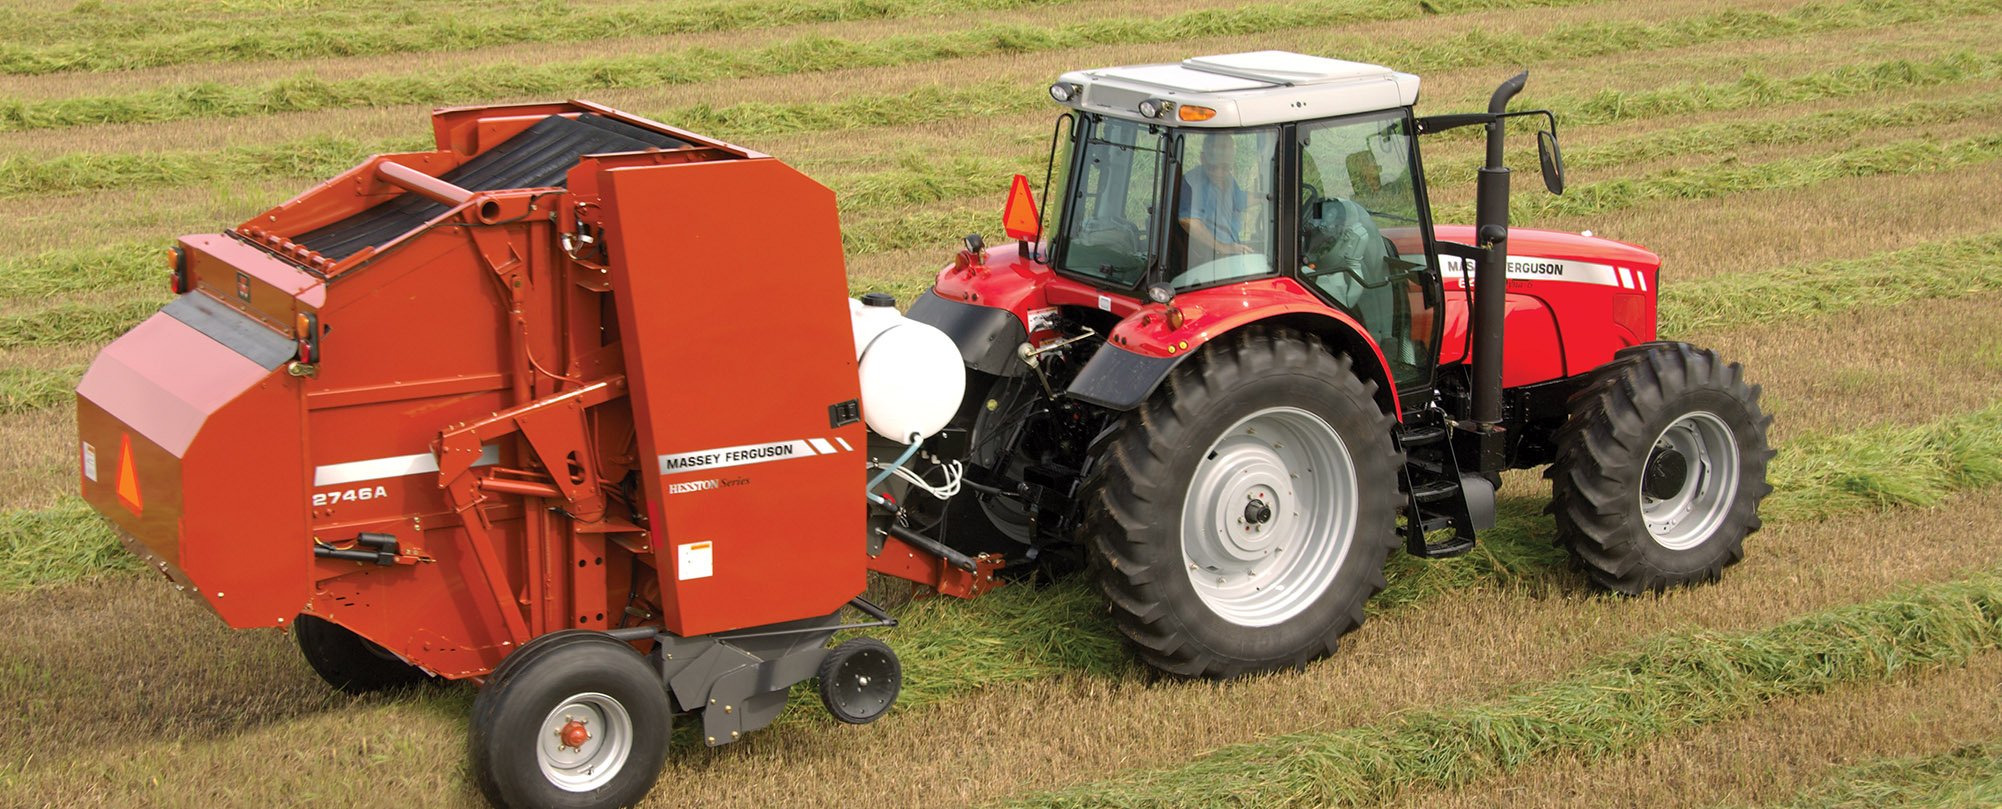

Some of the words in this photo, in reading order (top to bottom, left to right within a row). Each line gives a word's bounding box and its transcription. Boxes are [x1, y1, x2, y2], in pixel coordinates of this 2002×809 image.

[1507, 262, 1563, 275] ERGUSON
[667, 454, 720, 470] MASSEY
[726, 444, 793, 462] FERGUSON
[669, 479, 719, 495] HESSTON
[720, 476, 750, 488] Series
[312, 487, 387, 506] 2746A
